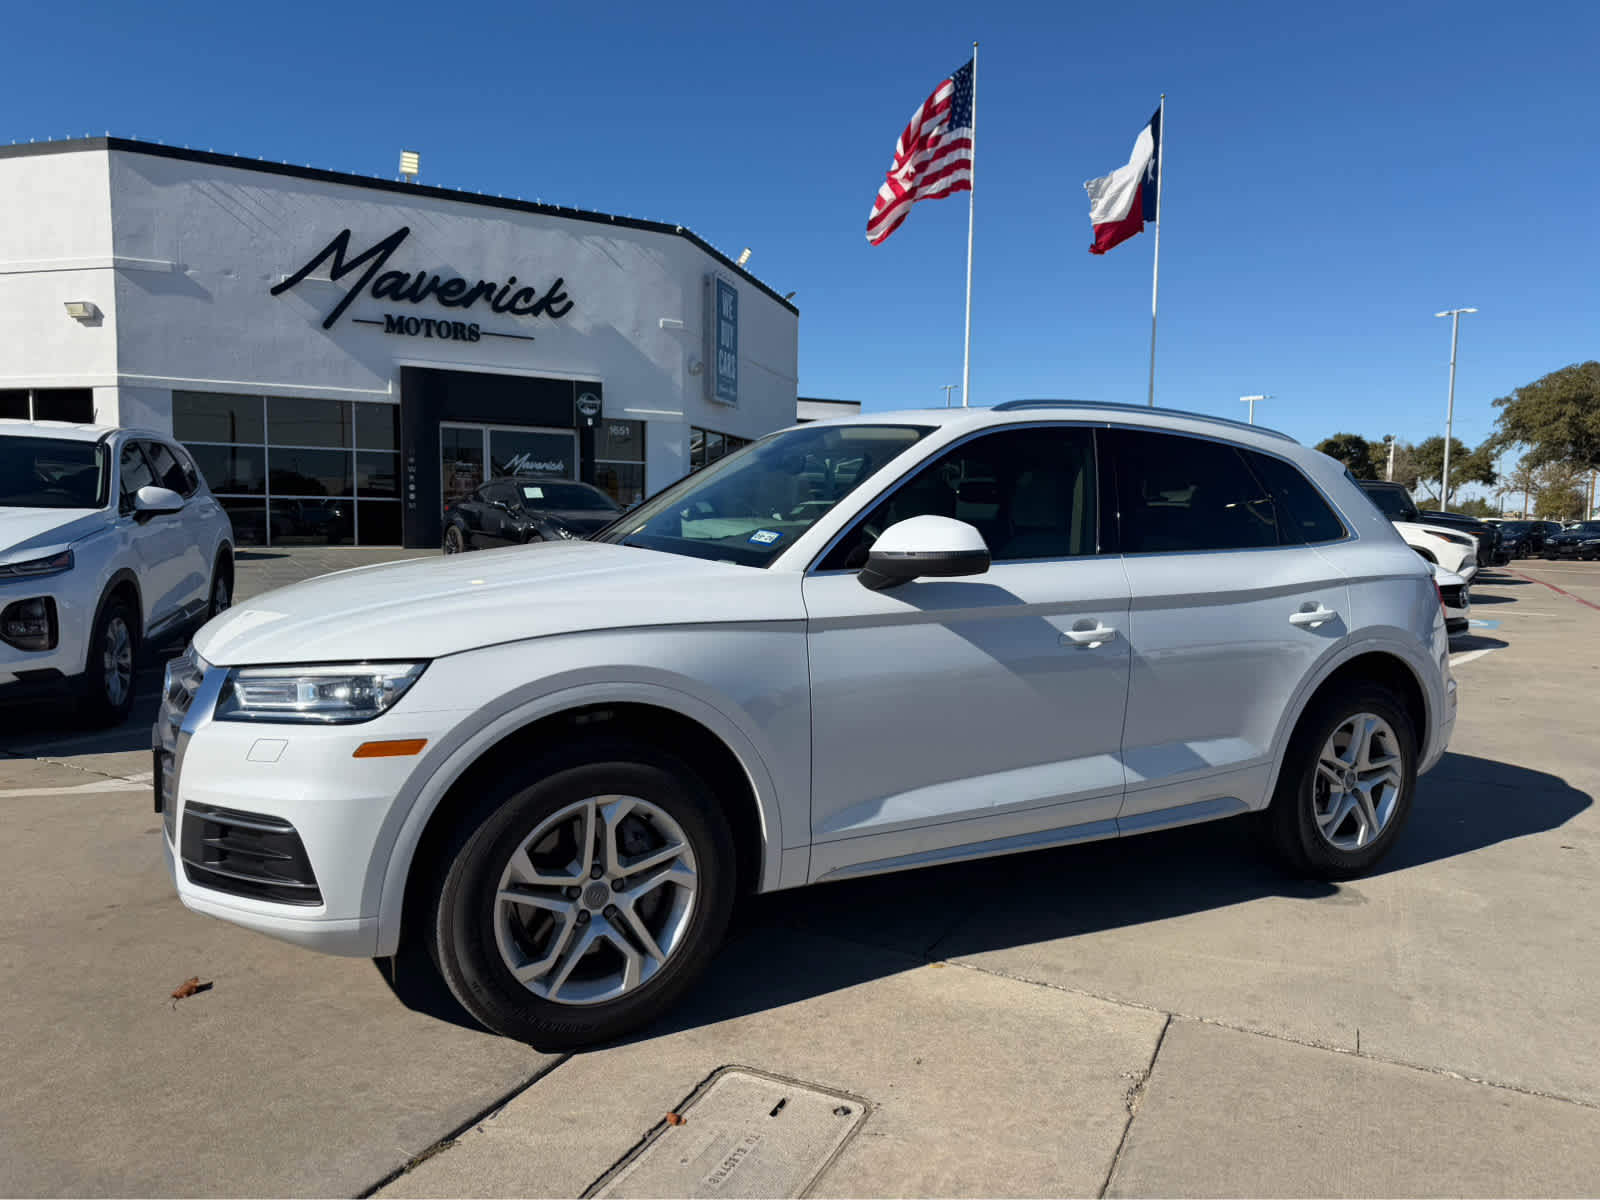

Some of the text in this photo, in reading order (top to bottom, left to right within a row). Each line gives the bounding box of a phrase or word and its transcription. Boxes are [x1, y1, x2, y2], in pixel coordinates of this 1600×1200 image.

[270, 226, 575, 329] Maverick
[384, 313, 481, 343] MOTORS
[718, 348, 736, 380] CARS
[503, 452, 565, 475] Maverick
